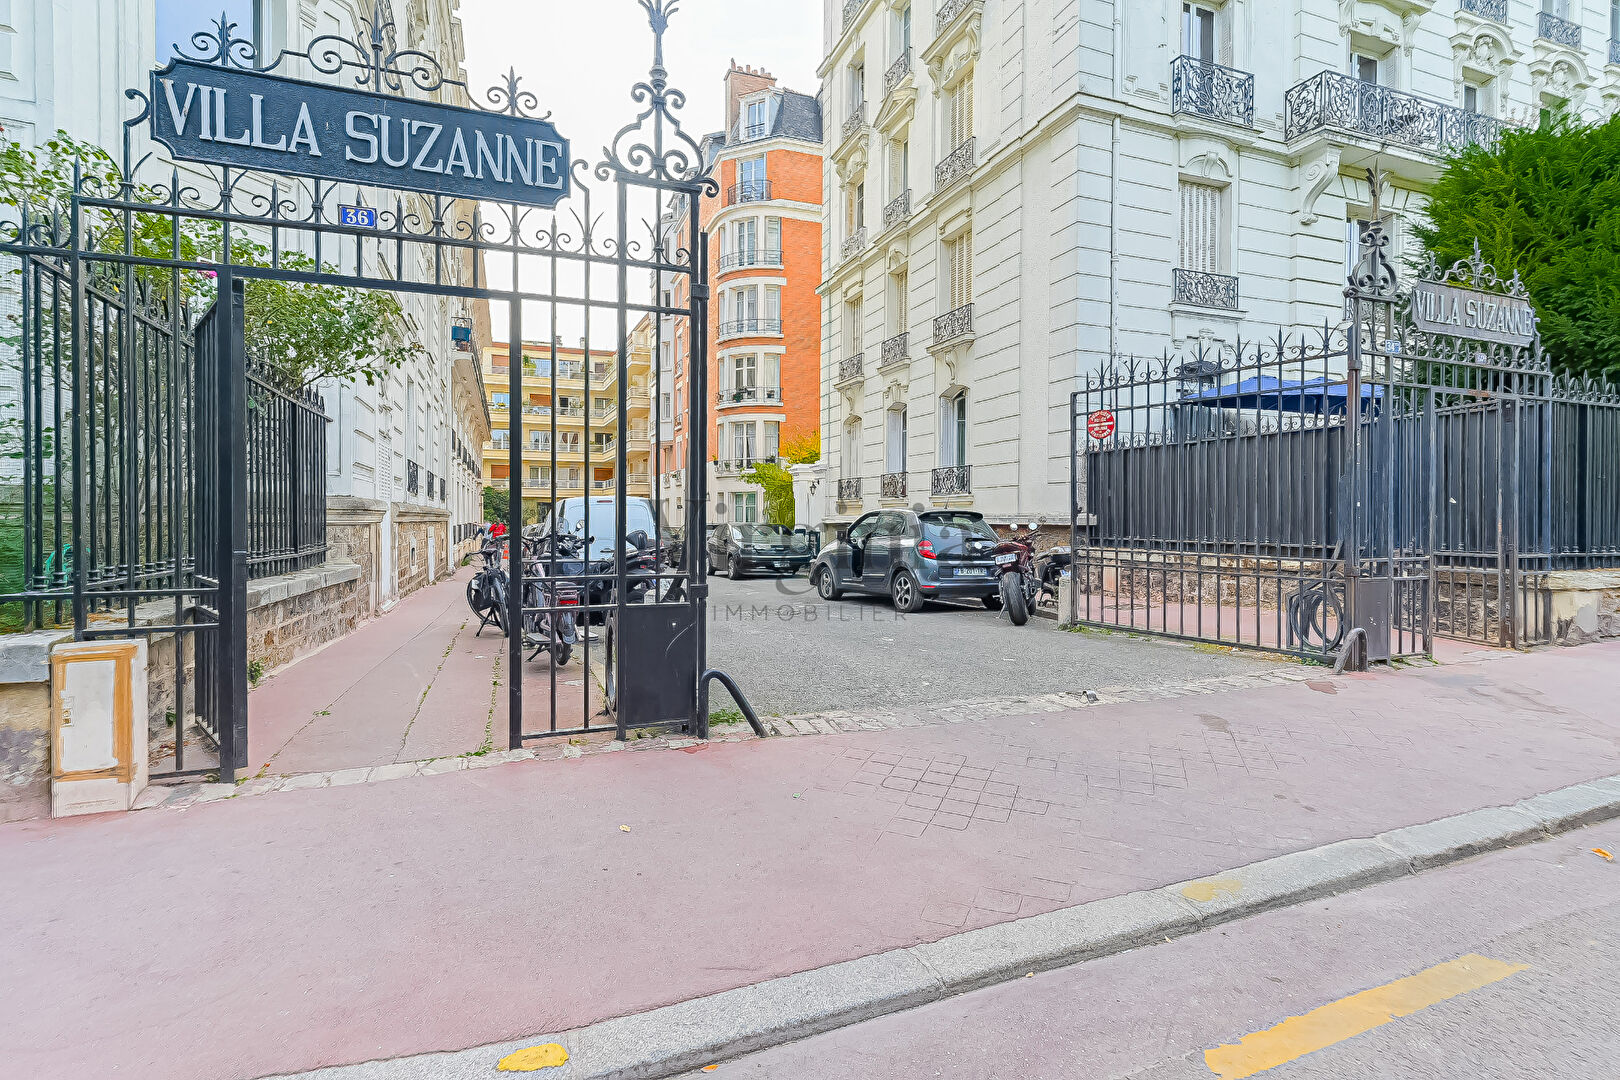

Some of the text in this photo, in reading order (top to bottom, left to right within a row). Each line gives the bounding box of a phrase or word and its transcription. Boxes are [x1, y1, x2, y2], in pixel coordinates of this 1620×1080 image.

[159, 78, 563, 189] VILLA SUZANNE
[346, 208, 369, 226] 36
[1414, 289, 1534, 336] VILLA SUZANNE
